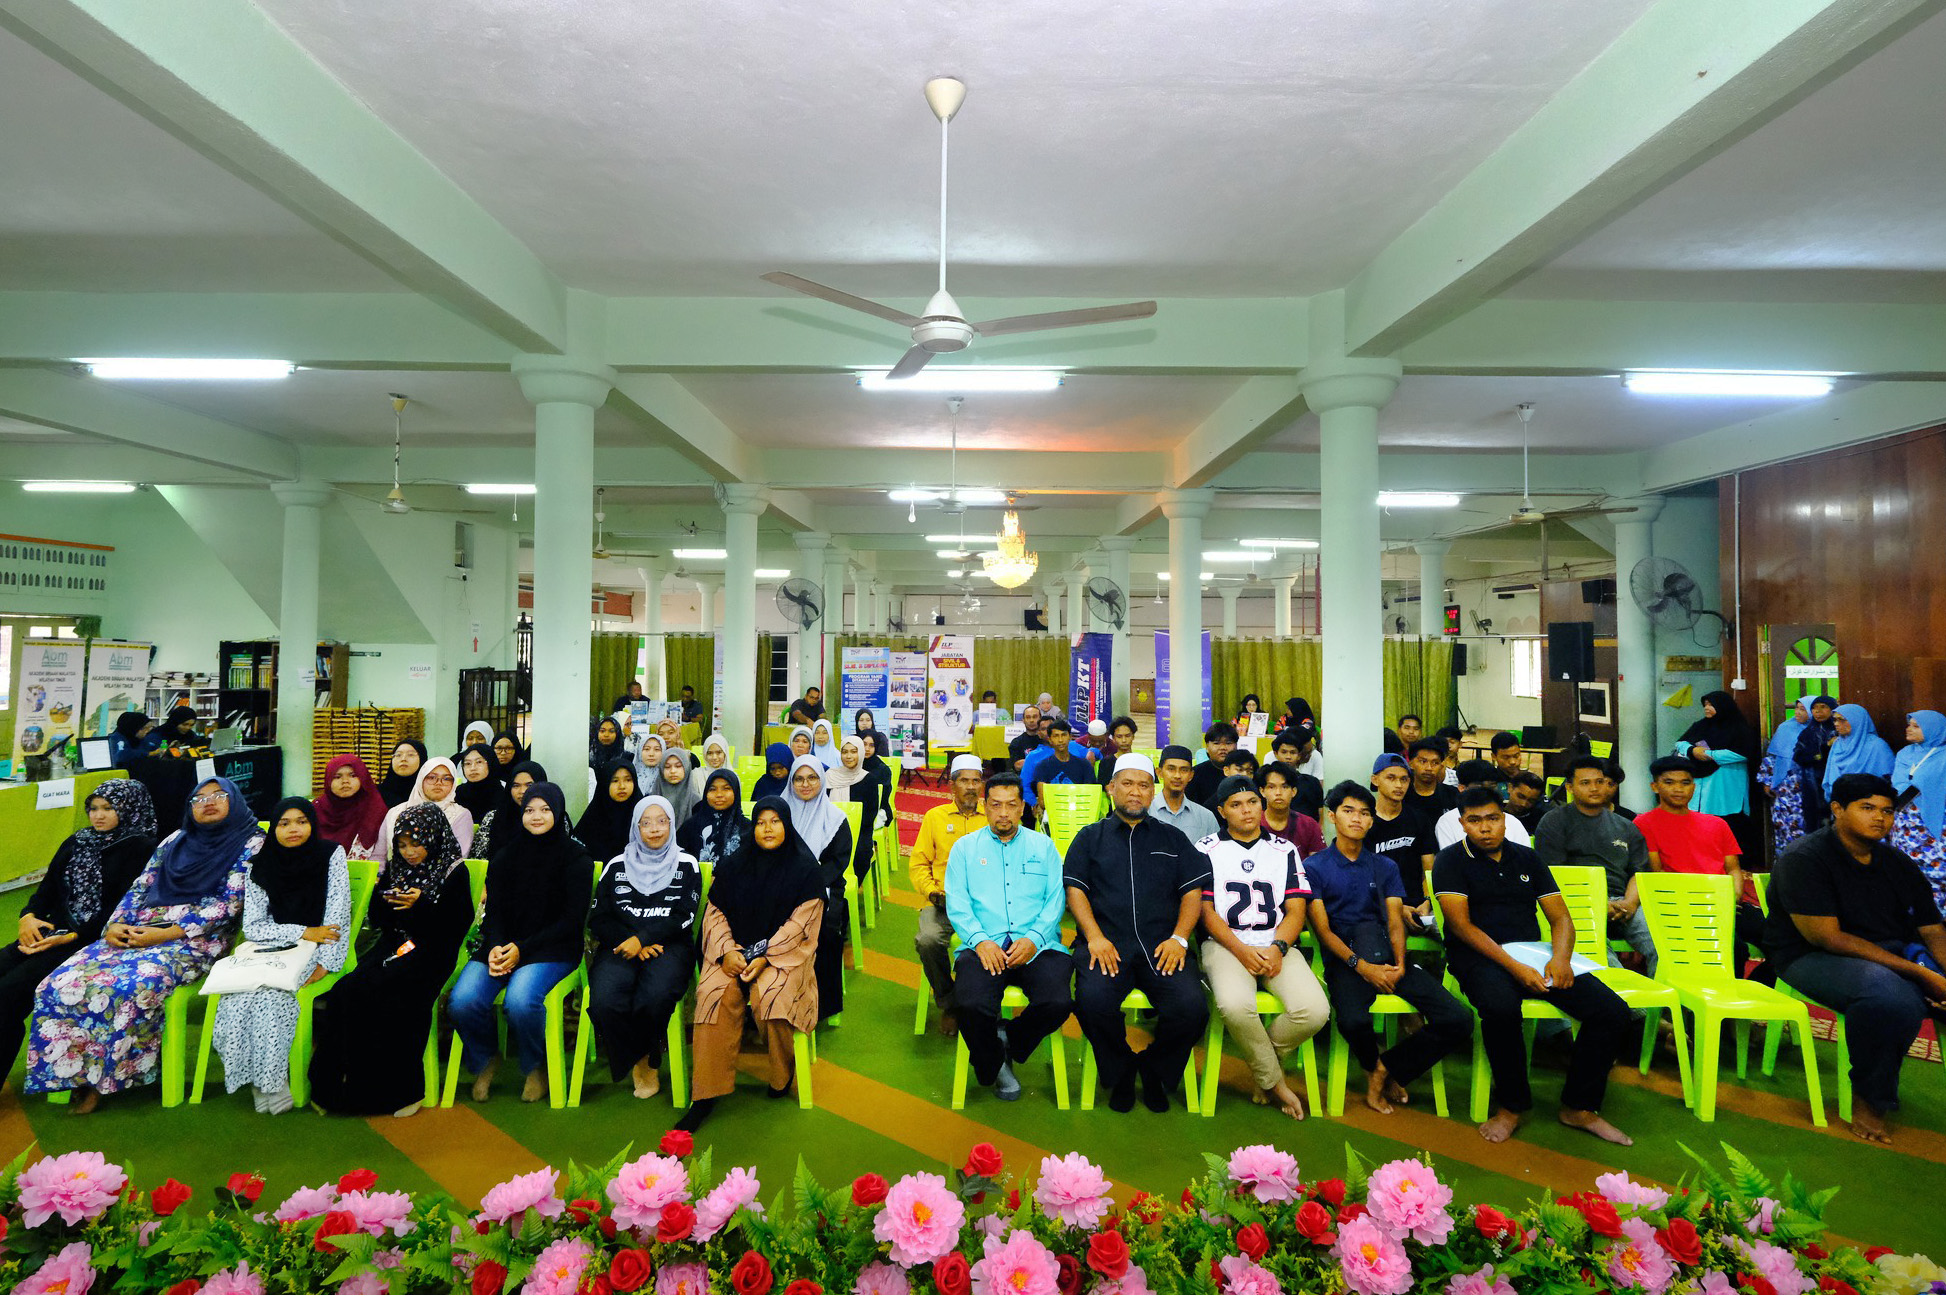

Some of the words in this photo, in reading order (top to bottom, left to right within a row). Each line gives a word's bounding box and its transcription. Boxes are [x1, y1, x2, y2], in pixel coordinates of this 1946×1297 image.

[109, 652, 133, 665] Abm
[1075, 657, 1090, 725] ILPKT
[225, 760, 254, 777] Abm
[1224, 880, 1278, 931] 23
